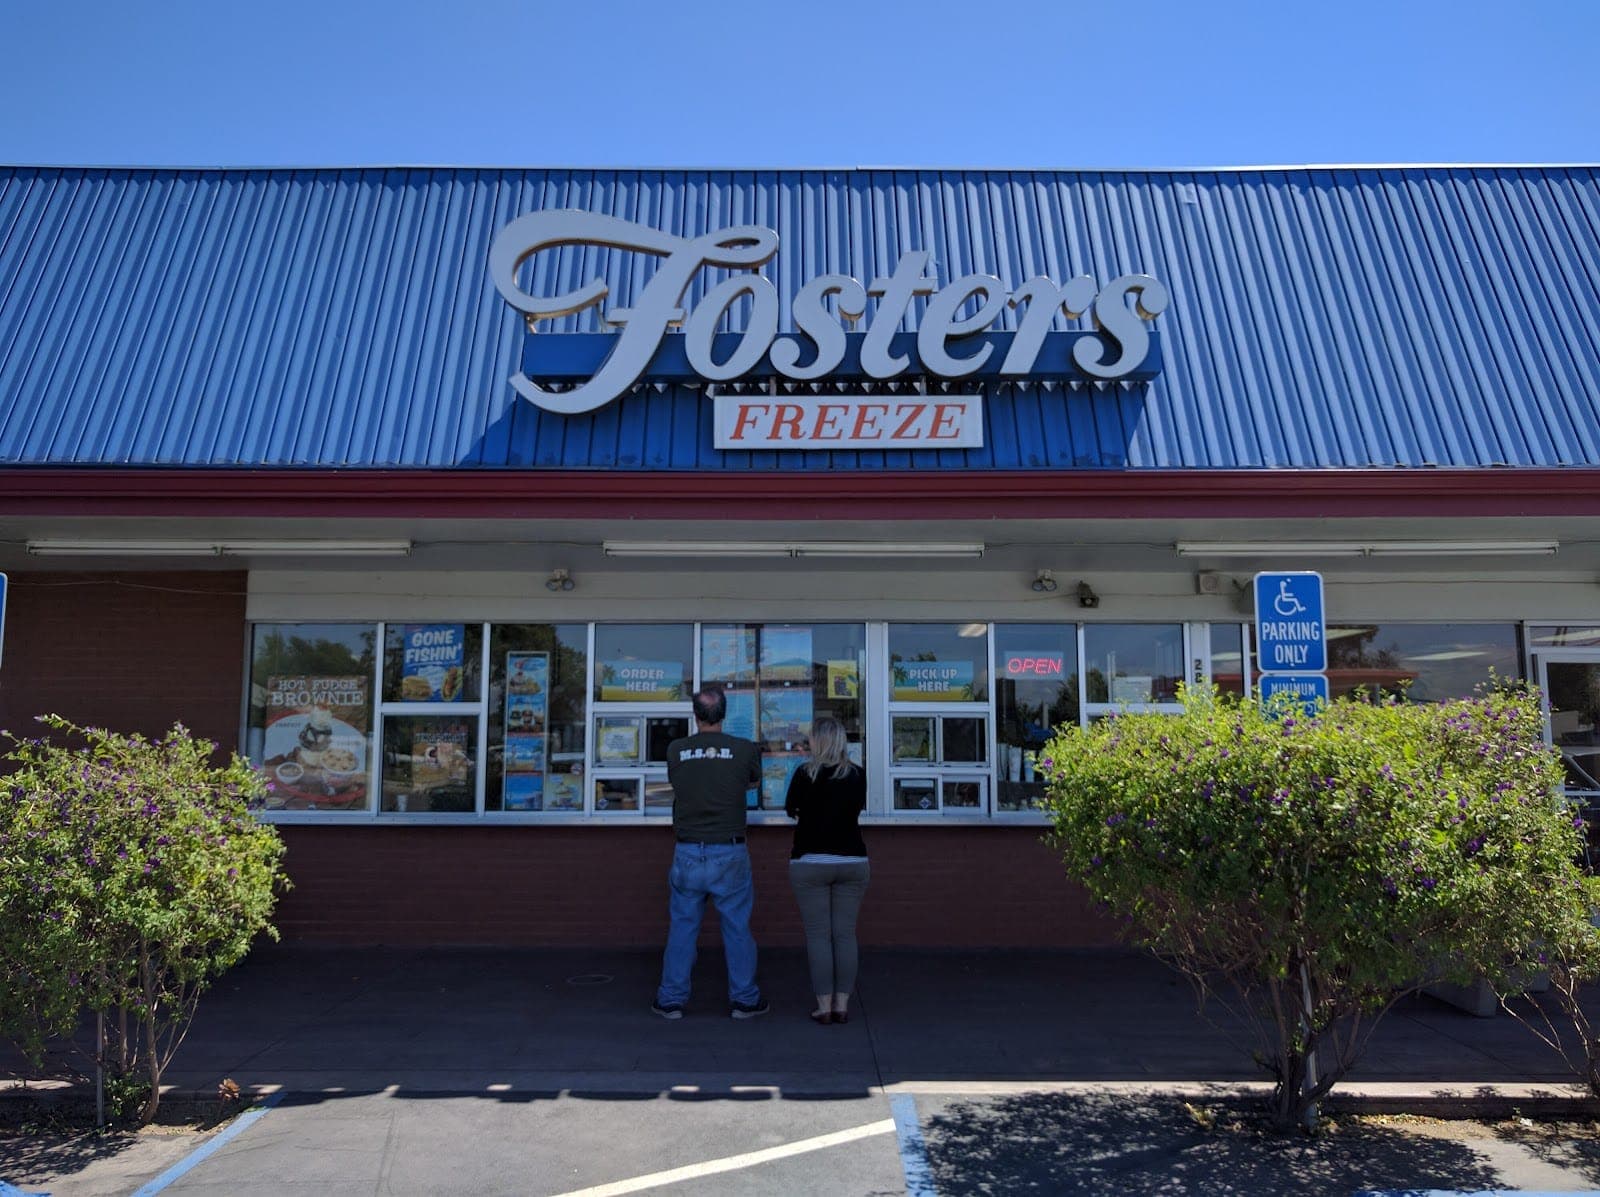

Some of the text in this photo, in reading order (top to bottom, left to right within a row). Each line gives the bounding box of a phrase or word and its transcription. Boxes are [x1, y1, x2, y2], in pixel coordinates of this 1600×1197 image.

[490, 209, 1168, 415] Fosters
[729, 404, 967, 441] FREEZE
[412, 629, 455, 647] GONE
[1262, 621, 1320, 641] PARKING
[406, 643, 463, 663] FISHIN'
[1274, 645, 1309, 664] ONLY
[620, 668, 664, 679] ORDER
[909, 668, 958, 679] PICK UP
[1007, 657, 1063, 674] OPEN
[278, 679, 358, 690] HOT FUDGE
[626, 681, 658, 693] HERE
[917, 681, 950, 692] HERE
[1270, 683, 1316, 697] MINIMUM
[271, 690, 364, 706] BROWNIE
